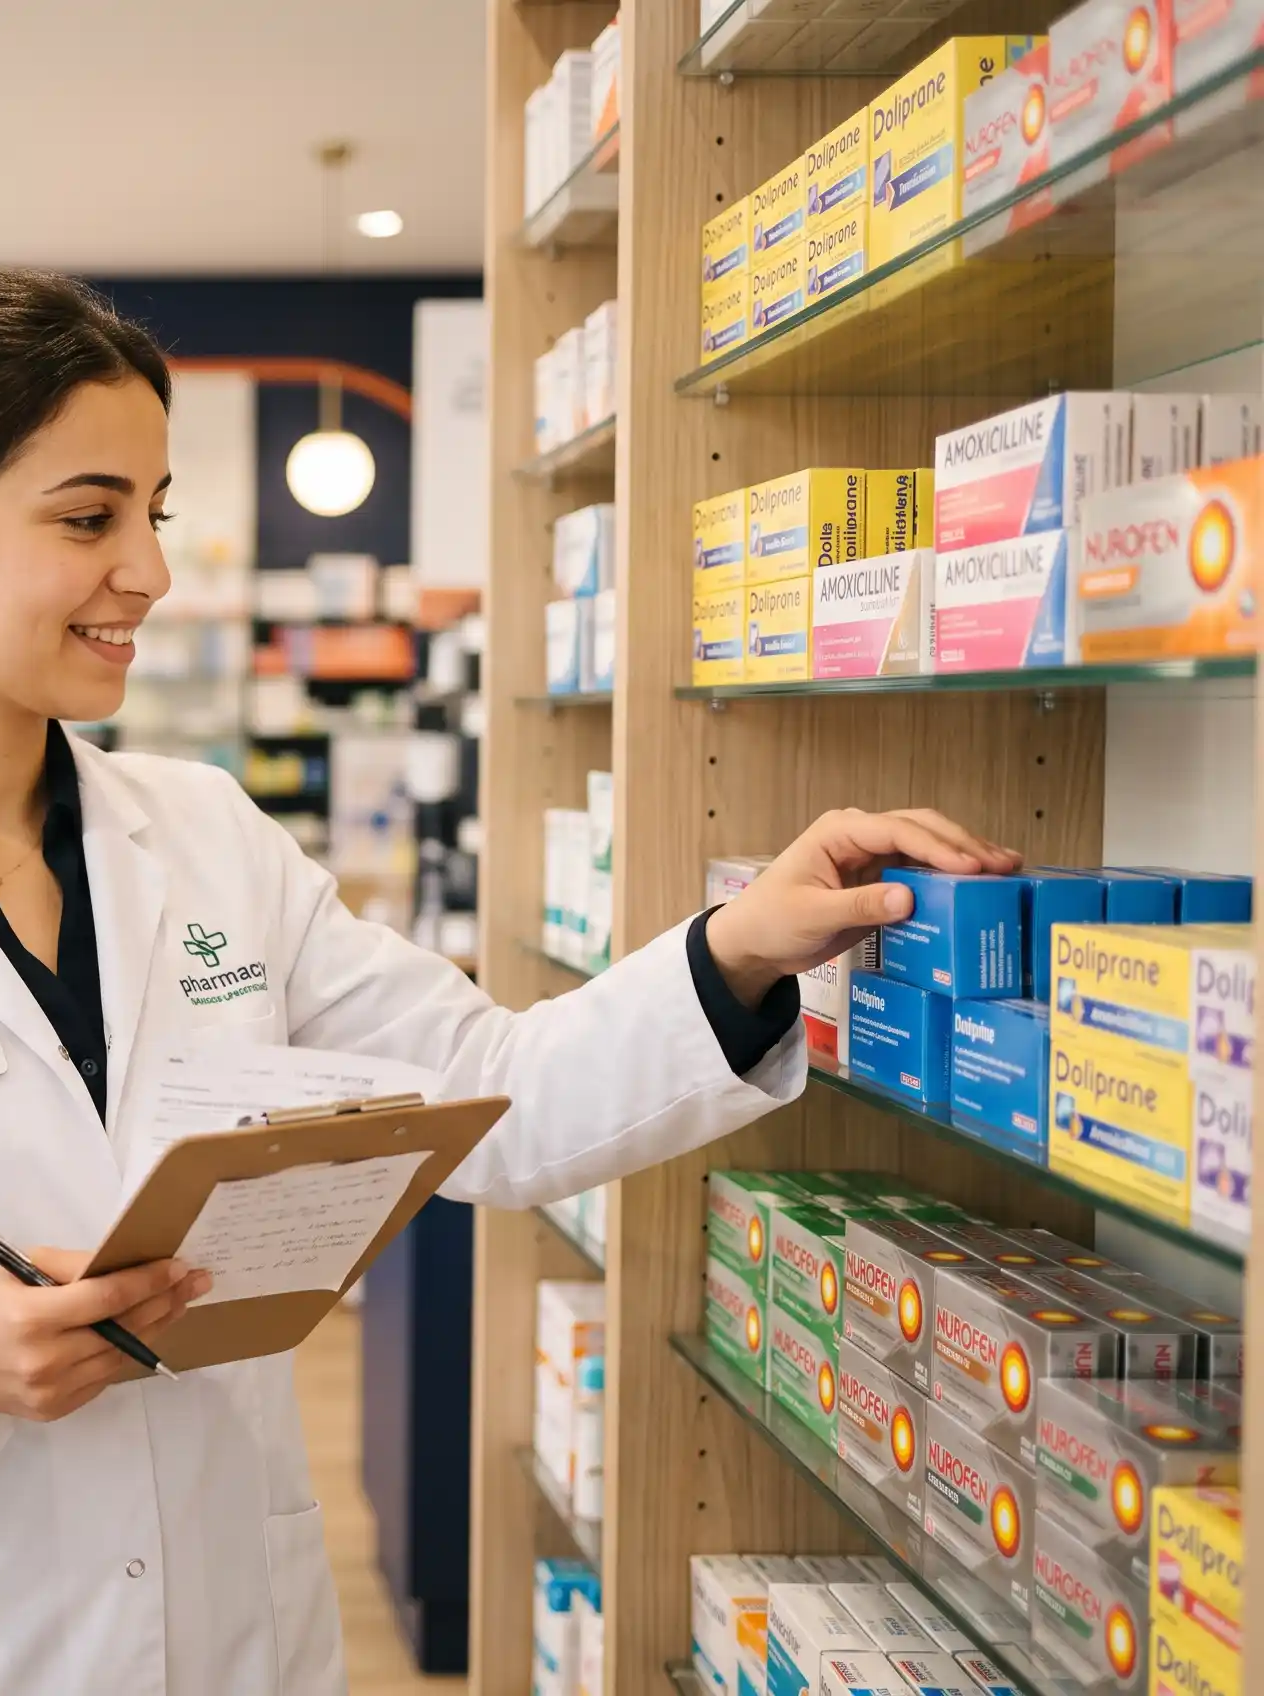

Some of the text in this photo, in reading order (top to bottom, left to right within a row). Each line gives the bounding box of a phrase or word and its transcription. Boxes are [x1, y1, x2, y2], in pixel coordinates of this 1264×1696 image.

[873, 71, 946, 142] Doliprane
[807, 125, 860, 177] Doliprane
[807, 219, 858, 262] Doliprane
[944, 411, 1044, 468] AMOXICILLINE
[820, 565, 900, 603] AMOXICILLINE
[945, 546, 1044, 587] AMOXICILLINE
[179, 960, 267, 998] pharmacy
[1057, 933, 1161, 986] Doliprane
[1055, 1050, 1158, 1113] Doliprane
[846, 1250, 897, 1302] NUROFEN
[936, 1304, 999, 1366] NUROFEN
[839, 1371, 889, 1426] NUROFEN
[929, 1437, 988, 1506] NUROFEN
[1039, 1418, 1109, 1480] NUROFEN
[1035, 1547, 1102, 1621] NUROFEN
